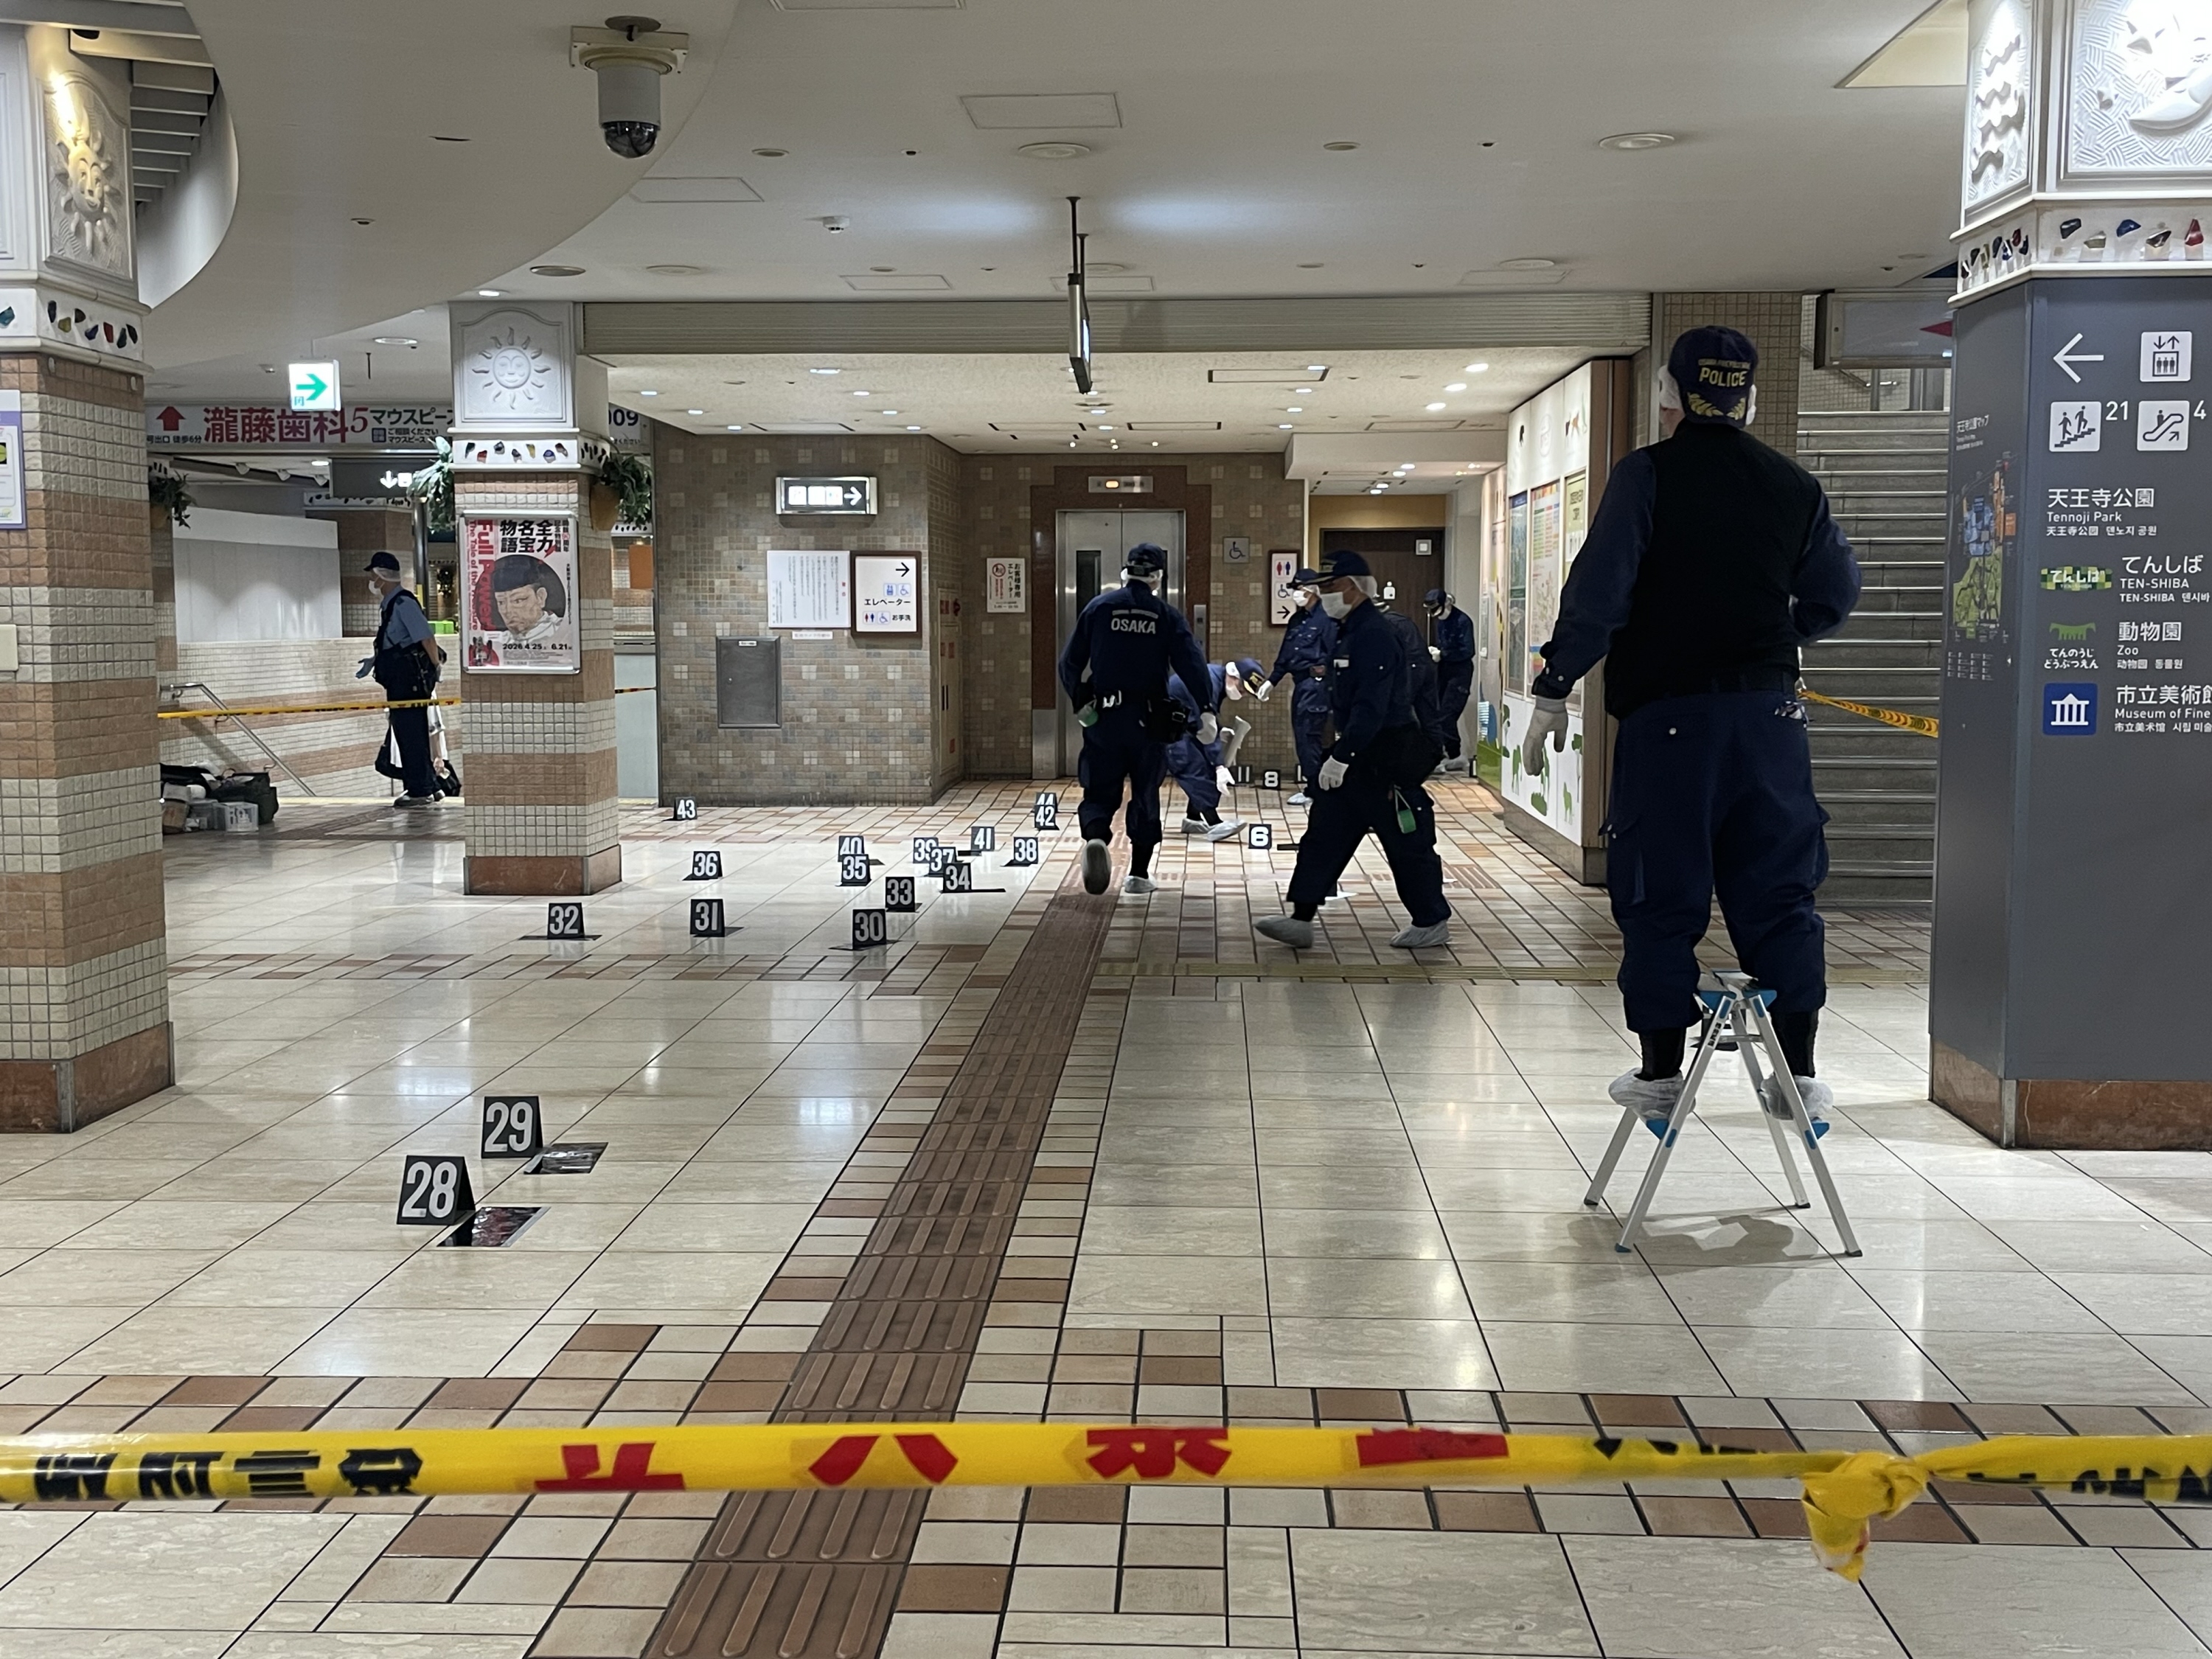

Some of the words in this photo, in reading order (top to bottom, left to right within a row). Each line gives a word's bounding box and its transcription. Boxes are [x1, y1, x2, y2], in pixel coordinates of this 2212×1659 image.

[1699, 367, 1748, 388] POLICE
[609, 408, 639, 426] 09
[2105, 400, 2128, 420] 21
[2193, 400, 2207, 420] 4
[2048, 488, 2154, 508] 天王寺公園
[2046, 512, 2090, 524] Tennoji
[2094, 511, 2122, 522] Park
[477, 519, 494, 554] Full
[2121, 554, 2204, 574] てんしば
[2050, 569, 2106, 583] てんしば
[2120, 578, 2190, 589] TEN-SHIBA
[864, 598, 911, 606] エレベーター
[2119, 593, 2175, 602] TEN-SHIBA
[1111, 618, 1156, 634] OSAKA
[2118, 622, 2182, 641] 動物園
[2049, 647, 2095, 658] てんのうじ
[2117, 644, 2139, 655] Zoo
[2044, 658, 2099, 669] どうぶつえん
[2115, 708, 2166, 719] Museum
[2169, 708, 2181, 719] of
[2185, 708, 2211, 719] Fine
[1265, 771, 1279, 787] 8
[1298, 765, 1308, 782] 1
[676, 799, 696, 819] 43
[1035, 806, 1055, 827] 42
[839, 836, 863, 855] 40
[974, 827, 992, 849] 41
[1251, 826, 1269, 847] 6
[930, 848, 955, 872] 37
[1015, 838, 1037, 862] 38
[693, 852, 718, 877] 36
[842, 856, 867, 880] 35
[945, 865, 970, 891] 34
[886, 878, 913, 905] 33
[549, 905, 580, 935] 32
[695, 901, 718, 931] 31
[854, 911, 884, 942] 30
[484, 1101, 534, 1152] 29
[401, 1161, 458, 1219] 28
